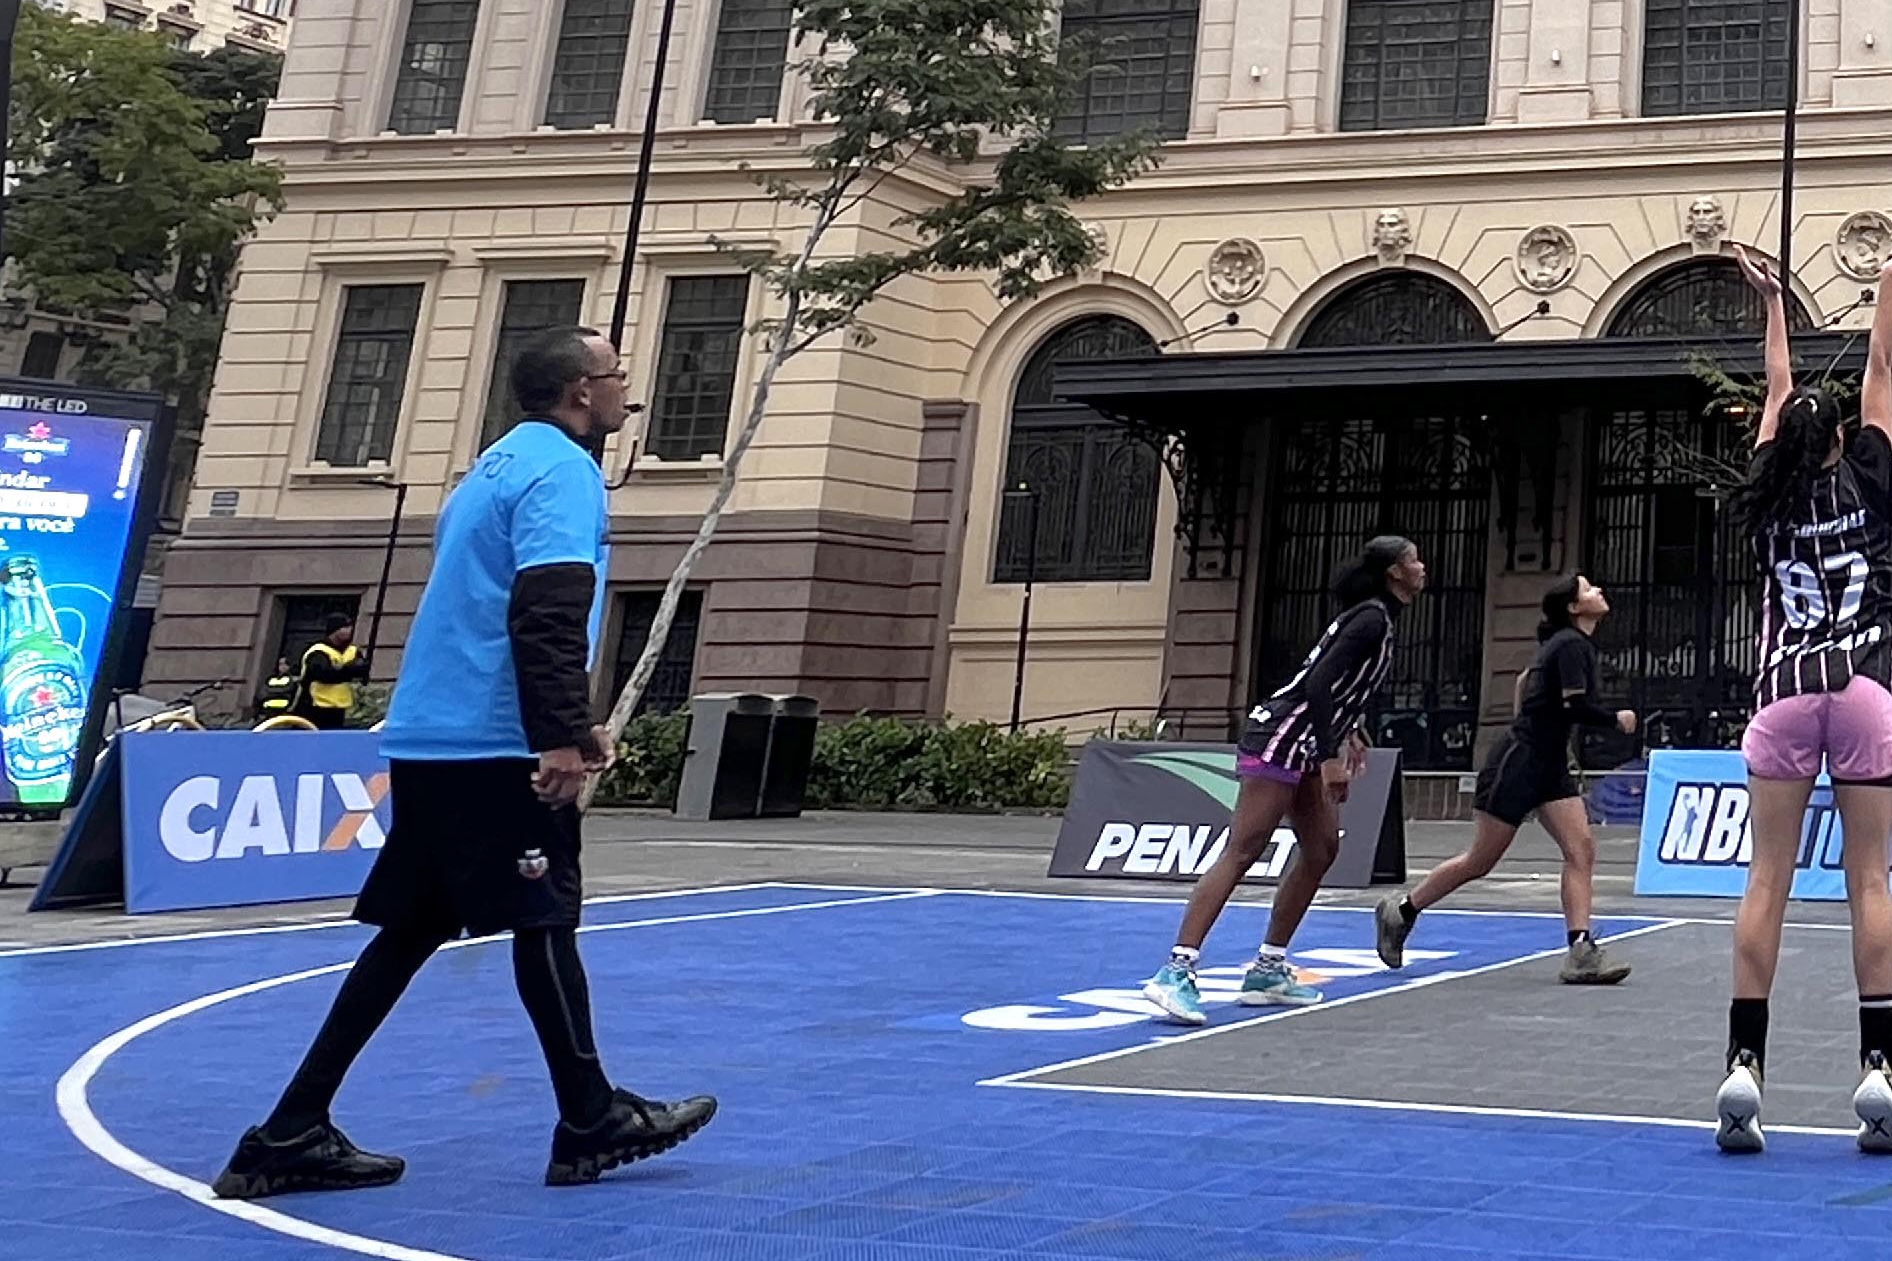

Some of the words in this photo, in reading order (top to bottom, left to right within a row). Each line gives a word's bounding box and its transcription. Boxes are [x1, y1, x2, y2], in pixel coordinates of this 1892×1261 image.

[26, 396, 56, 411] THE
[57, 399, 87, 413] LED
[159, 772, 390, 863] CAIX
[1661, 786, 1752, 861] NB
